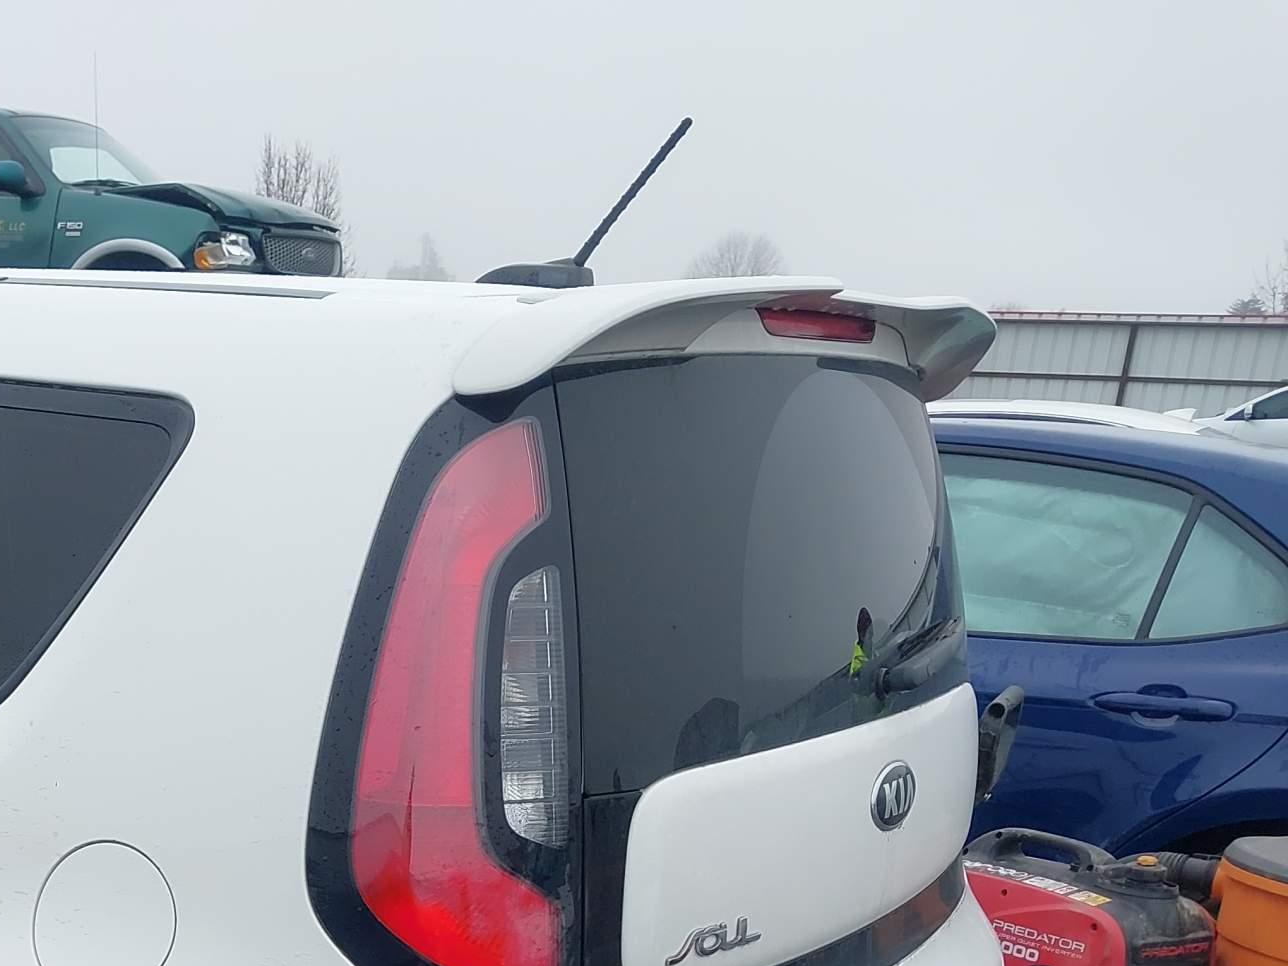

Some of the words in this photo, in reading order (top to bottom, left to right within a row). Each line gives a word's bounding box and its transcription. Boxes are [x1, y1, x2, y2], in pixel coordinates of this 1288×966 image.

[8, 222, 26, 231] LLC
[882, 774, 915, 819] KIA
[992, 919, 1086, 953] PREDATOR
[1000, 940, 1040, 962] 000
